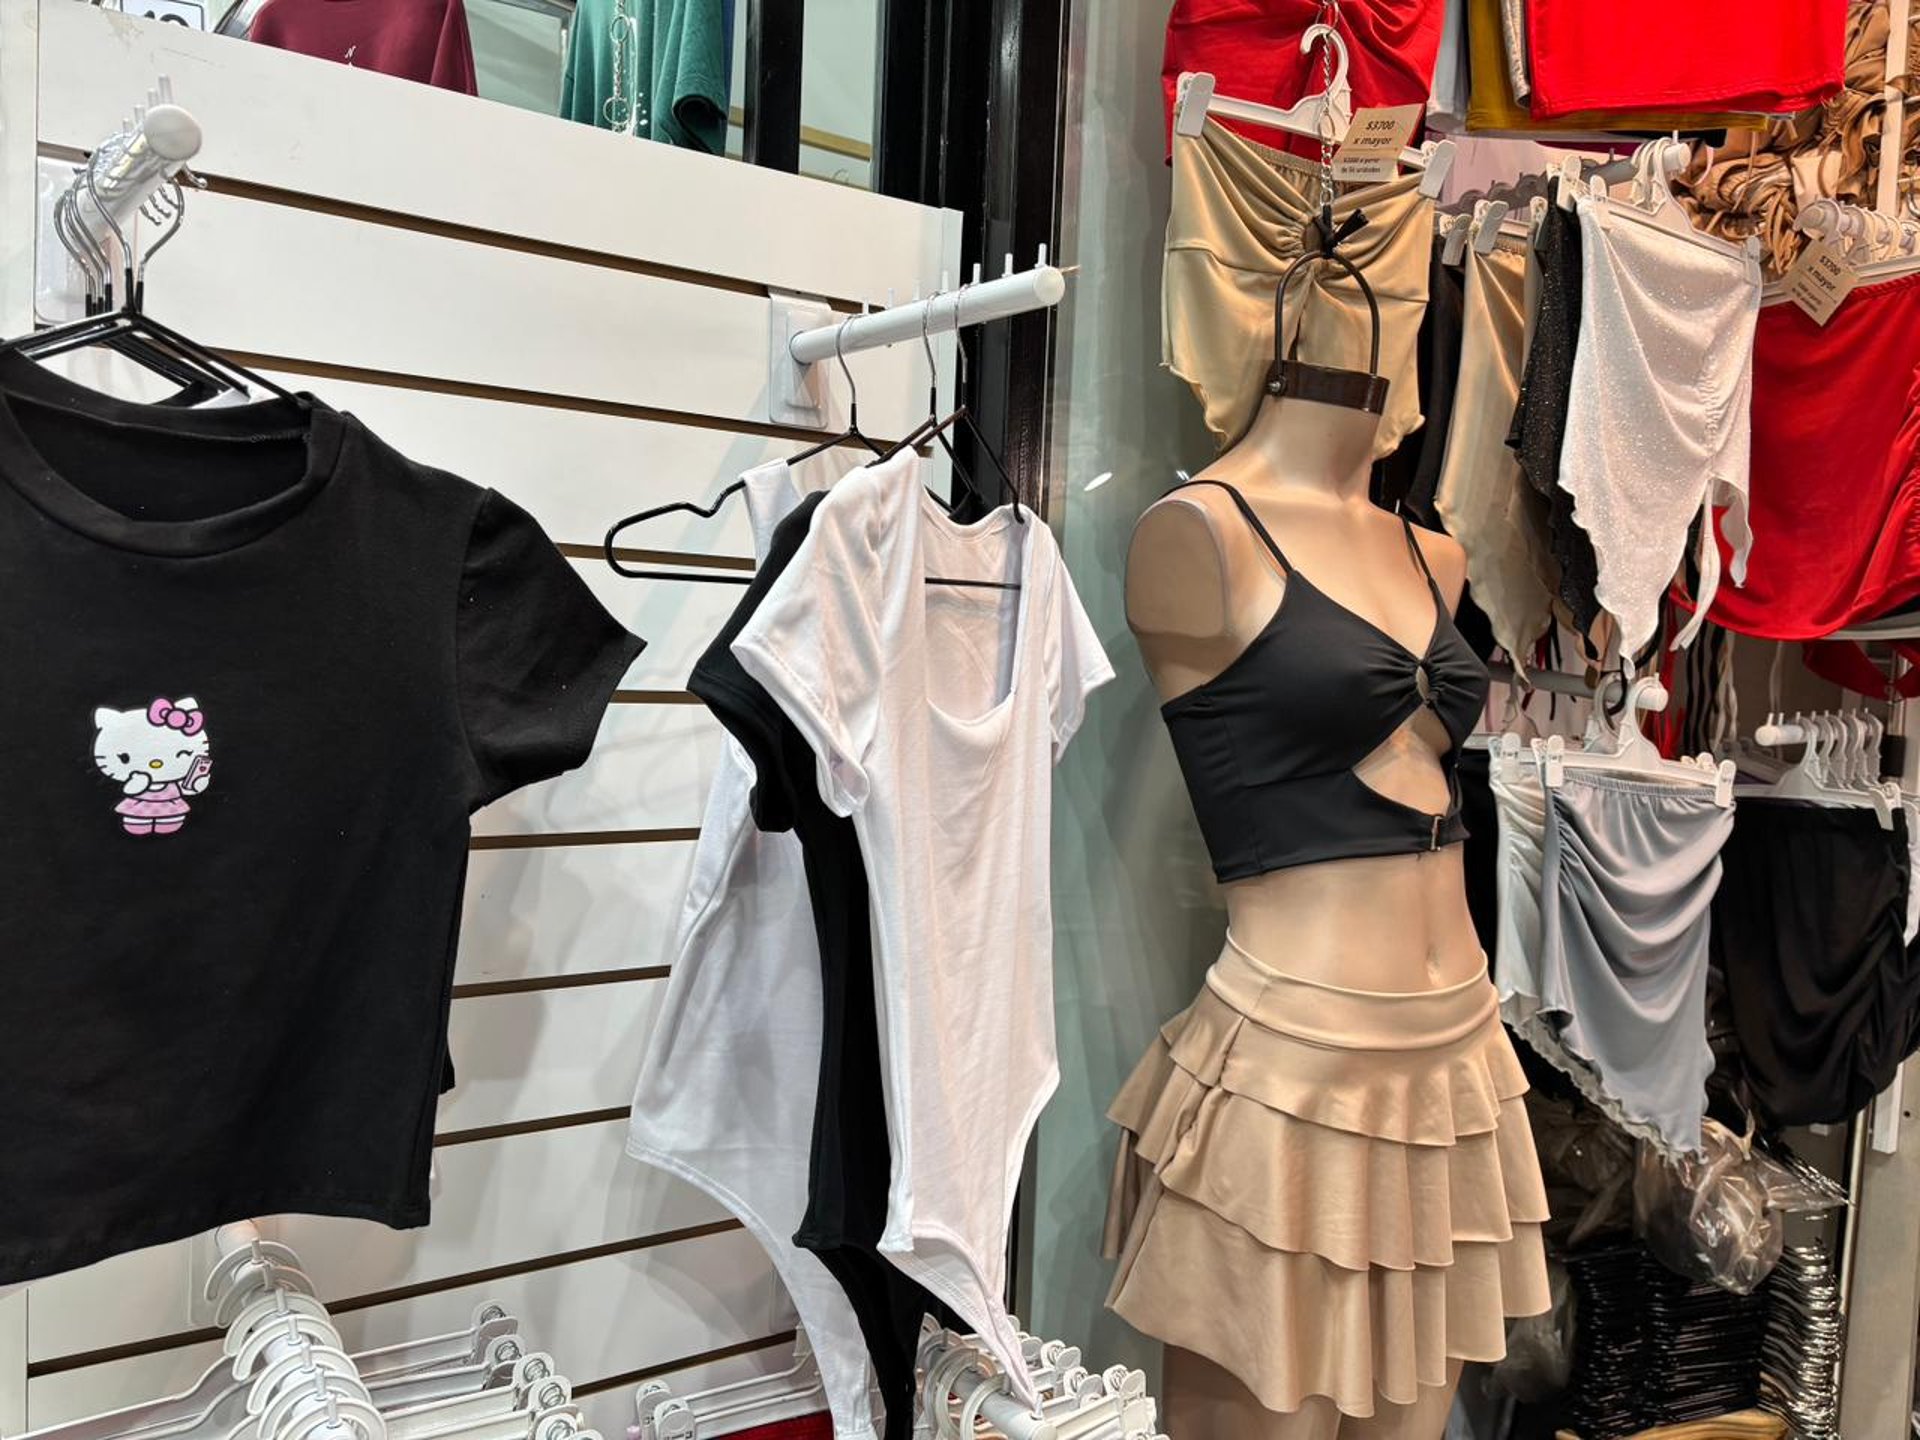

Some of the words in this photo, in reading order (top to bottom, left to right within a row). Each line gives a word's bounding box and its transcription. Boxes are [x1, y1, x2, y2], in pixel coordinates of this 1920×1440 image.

[1365, 120, 1396, 130] $3700
[1360, 137, 1392, 147] mayor
[1812, 270, 1836, 292] mayor
